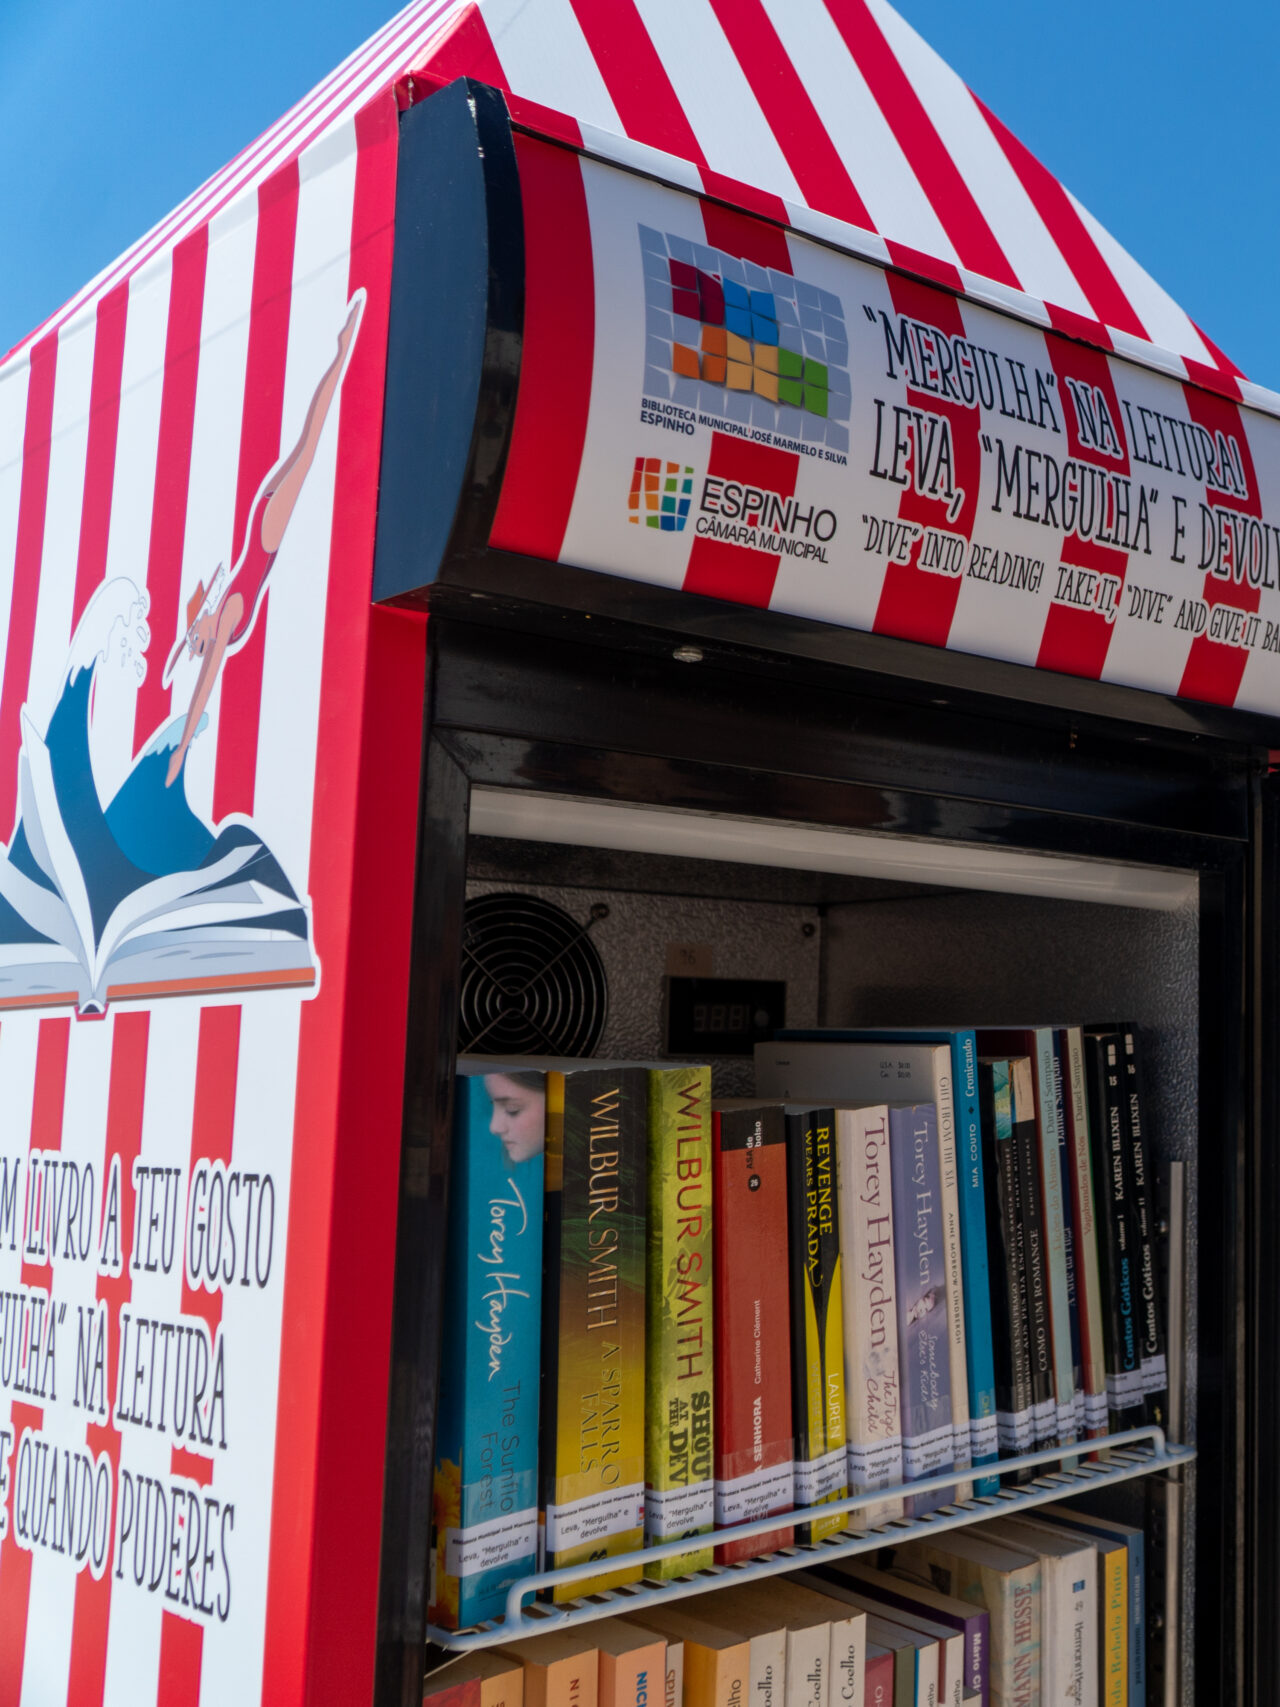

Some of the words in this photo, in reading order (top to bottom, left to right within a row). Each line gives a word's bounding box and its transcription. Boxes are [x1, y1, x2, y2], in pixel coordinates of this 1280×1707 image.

[640, 410, 696, 436] ESPINHO
[862, 304, 1061, 434] "MERGULHA"
[1067, 379, 1121, 456] NA
[1121, 399, 1247, 497] LEITURA!
[641, 397, 697, 423] BIBLIOTECA
[697, 414, 749, 438] MUNICIPAL
[750, 429, 772, 445] JOSÉ
[773, 436, 818, 457] MARMELO
[818, 448, 824, 459] E
[824, 451, 848, 467] SILVA
[868, 398, 962, 518] LEVA,
[981, 433, 1159, 556] "MERGULHA"
[1170, 494, 1188, 565] E
[699, 476, 838, 543] ESPINHO
[695, 515, 757, 547] CÂMARA
[758, 531, 829, 565] MUNICIPAL
[861, 513, 920, 561] "DIVE"
[920, 531, 965, 574] INTO
[966, 543, 1045, 594] READING!
[1053, 565, 1098, 607] TAKE
[1097, 577, 1119, 620] IT,
[1126, 583, 1174, 625] "DIVE"
[1173, 598, 1208, 634] AND
[1209, 607, 1245, 645] GIVE
[1243, 615, 1262, 647] IT
[938, 1076, 951, 1103] GIFT
[964, 1037, 976, 1099] Cronicando
[1043, 1050, 1054, 1098] Sampaio
[1071, 1047, 1083, 1090] Sampaio
[1108, 1074, 1118, 1087] 15
[941, 1106, 954, 1143] FROM
[1044, 1100, 1055, 1135] Daniel
[1072, 1090, 1084, 1123] Daniel
[1109, 1105, 1122, 1152] BLIXEN
[1128, 1092, 1141, 1138] BLIXEN
[587, 1087, 620, 1225] WILBUR
[746, 1135, 754, 1149] de
[753, 1120, 762, 1148] bolso
[804, 1129, 814, 1187] WEARS
[911, 1120, 929, 1187] Torey
[942, 1147, 955, 1164] THE
[969, 1122, 978, 1162] COUTO
[1078, 1136, 1087, 1157] Nós
[676, 1080, 703, 1243] WILBUR
[746, 1150, 754, 1169] ASA
[815, 1125, 834, 1235] REVENGE
[860, 1116, 889, 1208] Torey
[944, 1169, 956, 1188] SEA
[971, 1165, 980, 1189] MIA
[1079, 1158, 1088, 1172] de
[1112, 1154, 1125, 1201] KAREN
[1132, 1140, 1145, 1187] KAREN
[26, 1157, 95, 1263] LIVRO
[100, 1163, 121, 1268] A
[132, 1165, 182, 1275] TEU
[188, 1168, 276, 1290] GOSTO
[476, 1176, 528, 1266] Torey
[948, 1212, 956, 1238] ANNE
[1079, 1174, 1092, 1236] Vagabundos
[805, 1191, 824, 1288] PRADA
[912, 1190, 936, 1287] Hayden
[1117, 1220, 1127, 1252] volume
[586, 1227, 619, 1331] SMITH
[861, 1215, 893, 1350] Hayden
[949, 1239, 960, 1287] MORROW
[1029, 1227, 1043, 1298] ROMANCE
[1119, 1256, 1133, 1317] Góticos
[1141, 1243, 1155, 1301] Góticos
[474, 1271, 533, 1383] Hayden
[676, 1251, 704, 1381] SMITH
[753, 1299, 762, 1338] Clément
[952, 1289, 963, 1345] LINDBERGH
[1034, 1300, 1046, 1324] UM
[1145, 1301, 1158, 1354] Contos
[601, 1340, 622, 1361] A
[753, 1339, 762, 1385] Catherine
[1035, 1327, 1049, 1372] COMO
[1122, 1316, 1136, 1371] Contos
[0, 1290, 68, 1402] ULHA"
[73, 1305, 106, 1416] NA
[116, 1313, 228, 1451] LEITURA
[882, 1370, 898, 1400] The
[919, 1366, 929, 1404] Kids
[926, 1334, 941, 1412] Somebody
[501, 1379, 522, 1428] The
[600, 1366, 622, 1487] SPARRO
[669, 1397, 680, 1426] THE
[677, 1399, 689, 1422] AT
[827, 1372, 842, 1440] LAUREN
[866, 1378, 879, 1434] Child
[880, 1395, 898, 1438] Tige
[579, 1391, 600, 1475] FALLS
[690, 1389, 712, 1481] SHOU
[752, 1395, 763, 1463] SENHORA
[479, 1430, 499, 1513] Forest
[499, 1434, 521, 1514] Sunflo
[668, 1426, 690, 1487] DEV
[16, 1436, 110, 1570] QUANDO
[115, 1468, 236, 1624] PUDERES
[560, 1524, 581, 1536] Leva,
[581, 1508, 622, 1527] "Mergulha"
[623, 1508, 629, 1516] e
[579, 1524, 608, 1539] devolve
[666, 1515, 695, 1529] devolve
[668, 1500, 708, 1518] "Mergulha"
[722, 1503, 743, 1513] Leva,
[743, 1503, 769, 1517] devolve
[458, 1552, 480, 1564] Leva,
[524, 1535, 529, 1543] e
[480, 1552, 509, 1568] devolve
[1111, 1565, 1122, 1610] Pinto
[1013, 1582, 1032, 1647] HESSE
[972, 1631, 983, 1672] Mário
[1110, 1614, 1122, 1674] Rebelo
[635, 1671, 648, 1707] NIC
[840, 1644, 856, 1700] Coelho
